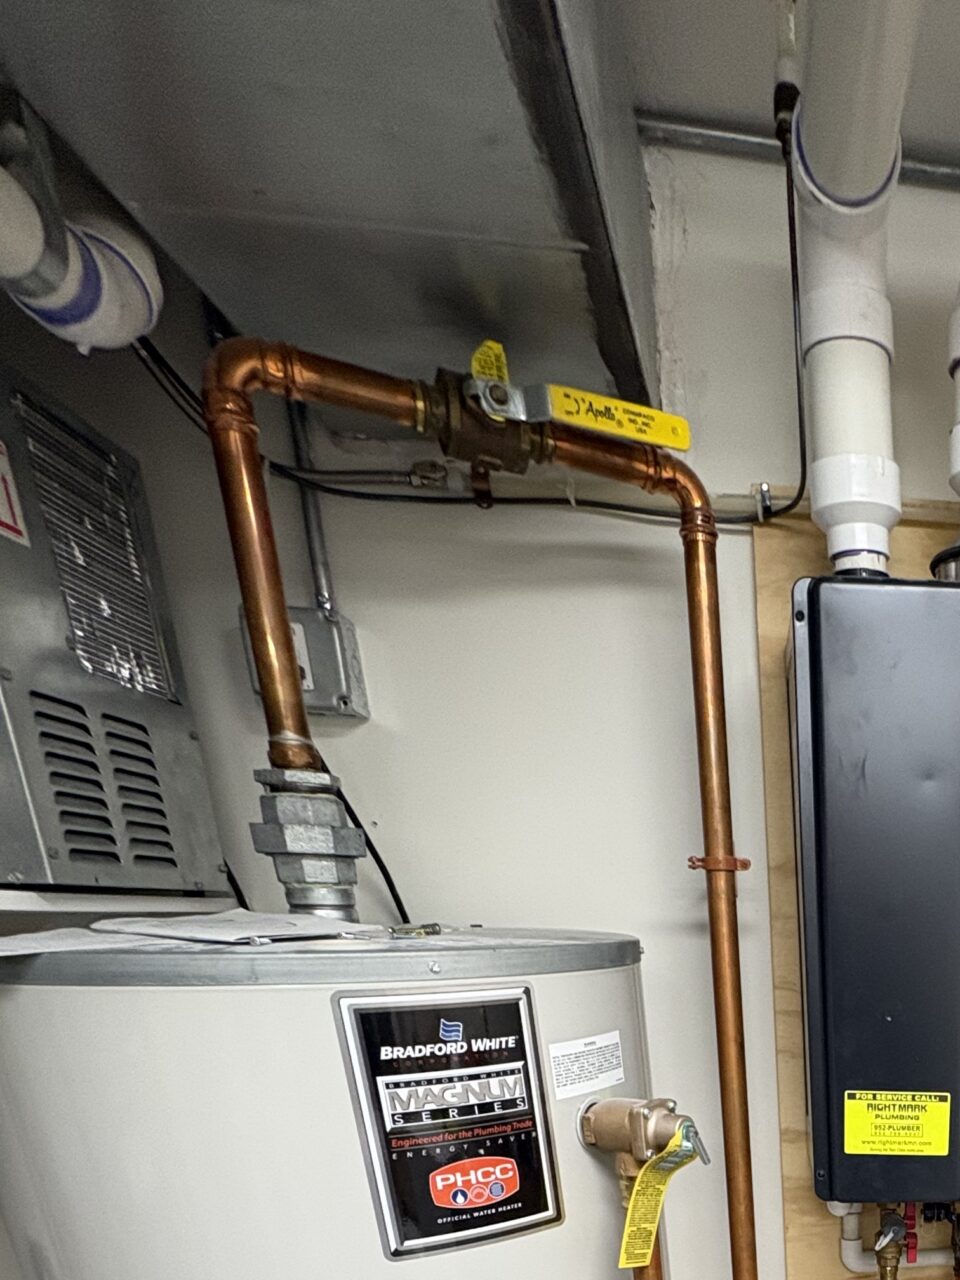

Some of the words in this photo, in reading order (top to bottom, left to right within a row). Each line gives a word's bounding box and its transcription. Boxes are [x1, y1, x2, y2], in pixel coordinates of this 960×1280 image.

[380, 1041, 468, 1060] BRADFORD
[471, 1036, 516, 1051] WHITE
[388, 1076, 469, 1089] BRADFORD
[480, 1070, 520, 1079] WHITE
[388, 1076, 525, 1112] MAGNUM
[876, 1093, 912, 1101] SERVICE
[393, 1098, 525, 1125] SERIES
[391, 1133, 443, 1148] Engineered
[444, 1132, 457, 1141] for
[458, 1129, 472, 1139] the
[474, 1124, 511, 1138] Plumbing
[513, 1120, 533, 1130] Trade
[392, 1143, 468, 1160] ENERGY
[486, 1131, 537, 1147] SAVER
[435, 1163, 514, 1190] PHCC
[437, 1214, 471, 1224] OFFICIAL
[473, 1208, 496, 1218] WATER
[498, 1202, 522, 1212] HEATER
